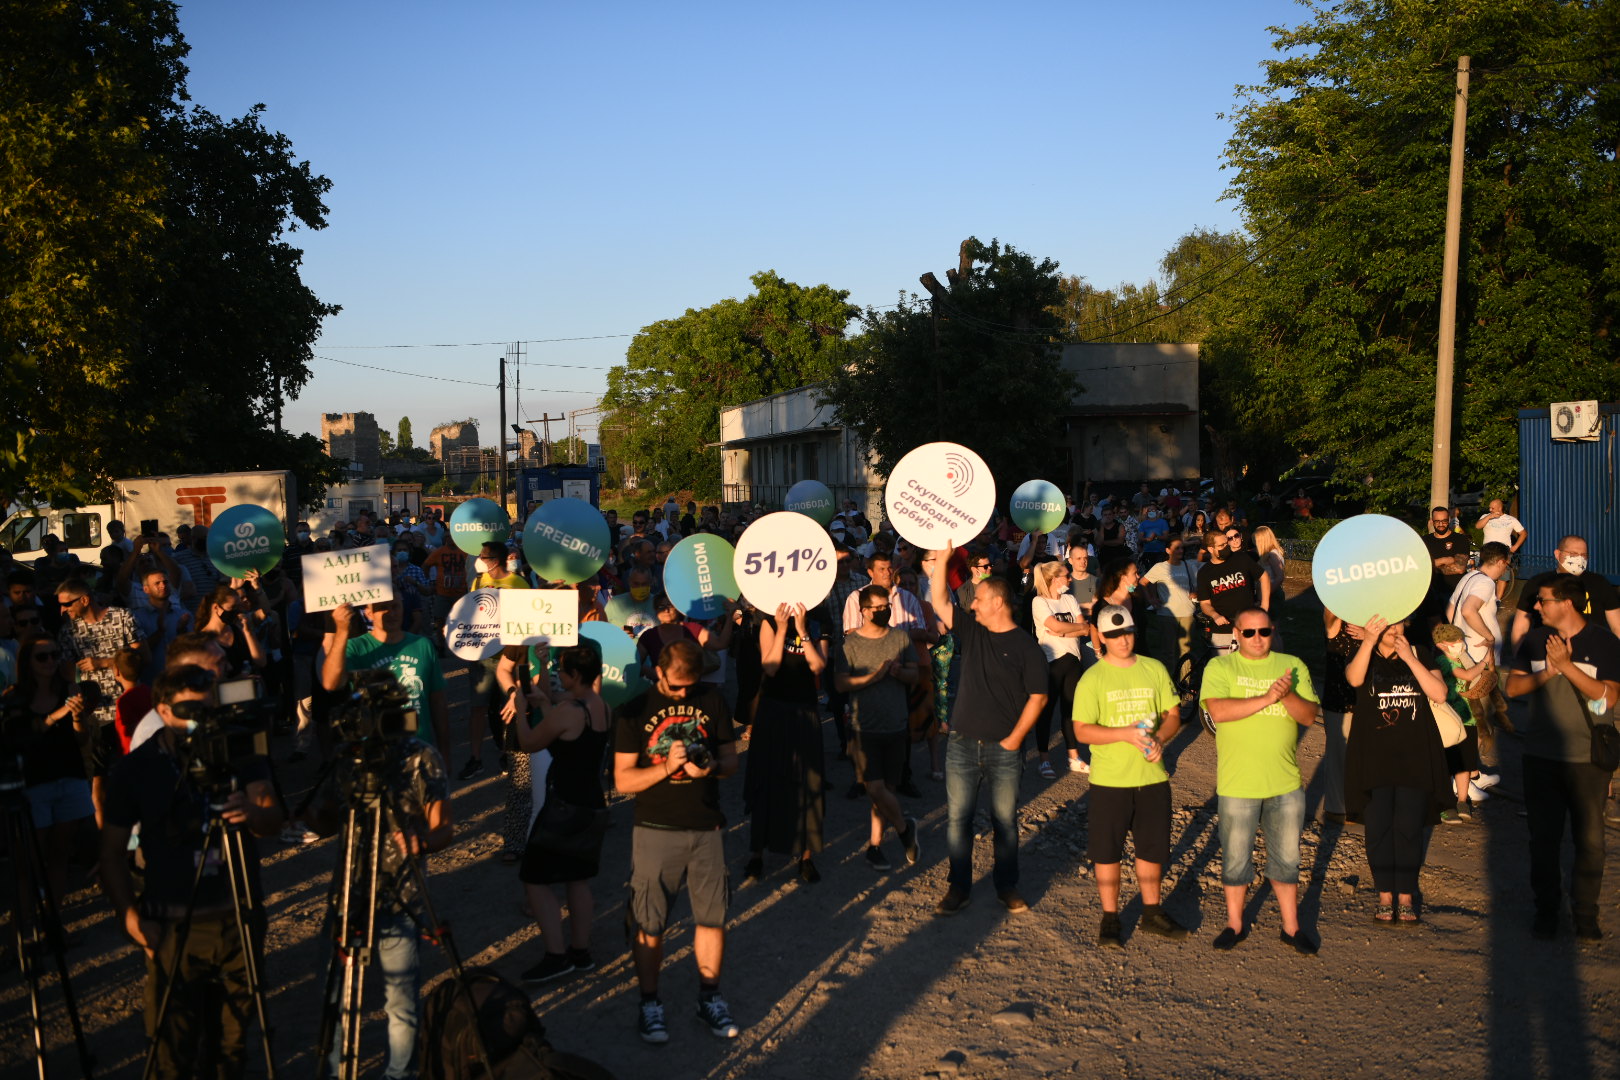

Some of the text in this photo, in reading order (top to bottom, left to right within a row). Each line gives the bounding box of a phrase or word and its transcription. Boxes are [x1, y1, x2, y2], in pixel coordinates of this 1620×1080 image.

[788, 499, 831, 511] СЛОБОДА
[899, 491, 958, 529] слободне
[907, 479, 977, 525] Скупштина
[1014, 500, 1062, 513] СЛОБОДА
[893, 501, 934, 530] Србије
[454, 522, 506, 533] СЛОБОДА
[224, 536, 270, 553] nova
[533, 521, 601, 561] FREEDOM
[323, 551, 371, 569] ДАЈТЕ
[744, 547, 828, 578] 51,1%
[336, 572, 361, 586] МИ
[693, 542, 716, 612] FREEDOM
[1325, 555, 1419, 585] SLOBODA
[319, 588, 381, 607] ВАЗДУХ!
[506, 621, 573, 637] ГДЕ СИ?
[454, 638, 487, 649] Србије
